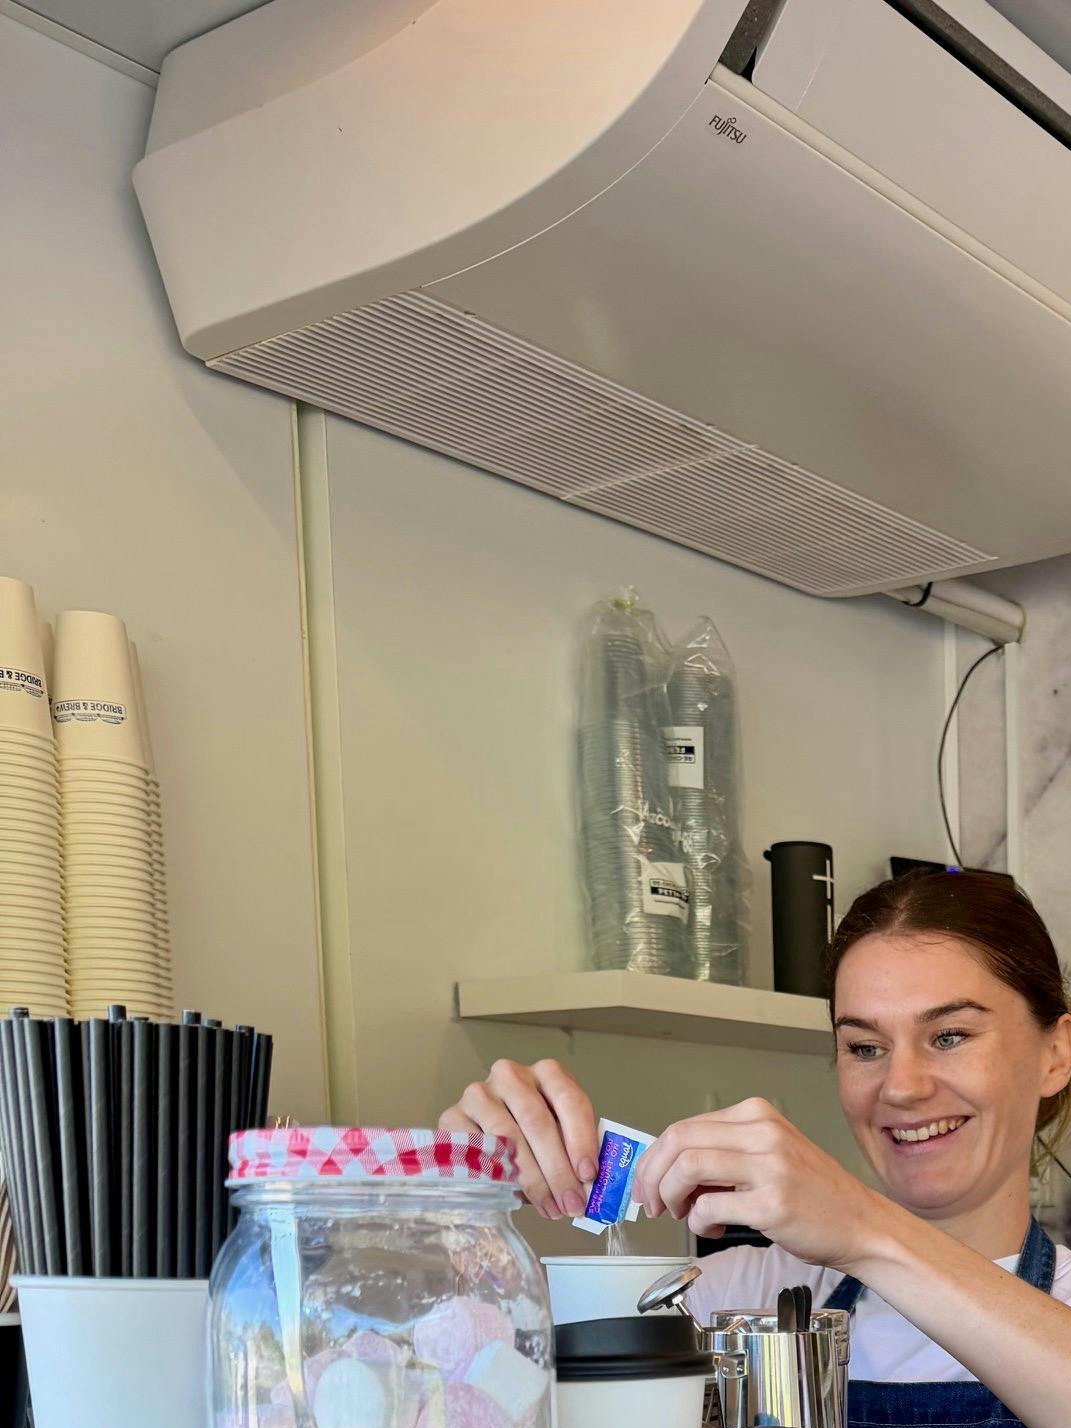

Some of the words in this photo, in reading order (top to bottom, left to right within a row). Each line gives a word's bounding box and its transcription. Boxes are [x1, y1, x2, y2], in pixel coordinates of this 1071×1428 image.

[709, 115, 747, 143] FUJITSU
[90, 702, 123, 714] BRIDGE
[618, 1141, 632, 1168] equal
